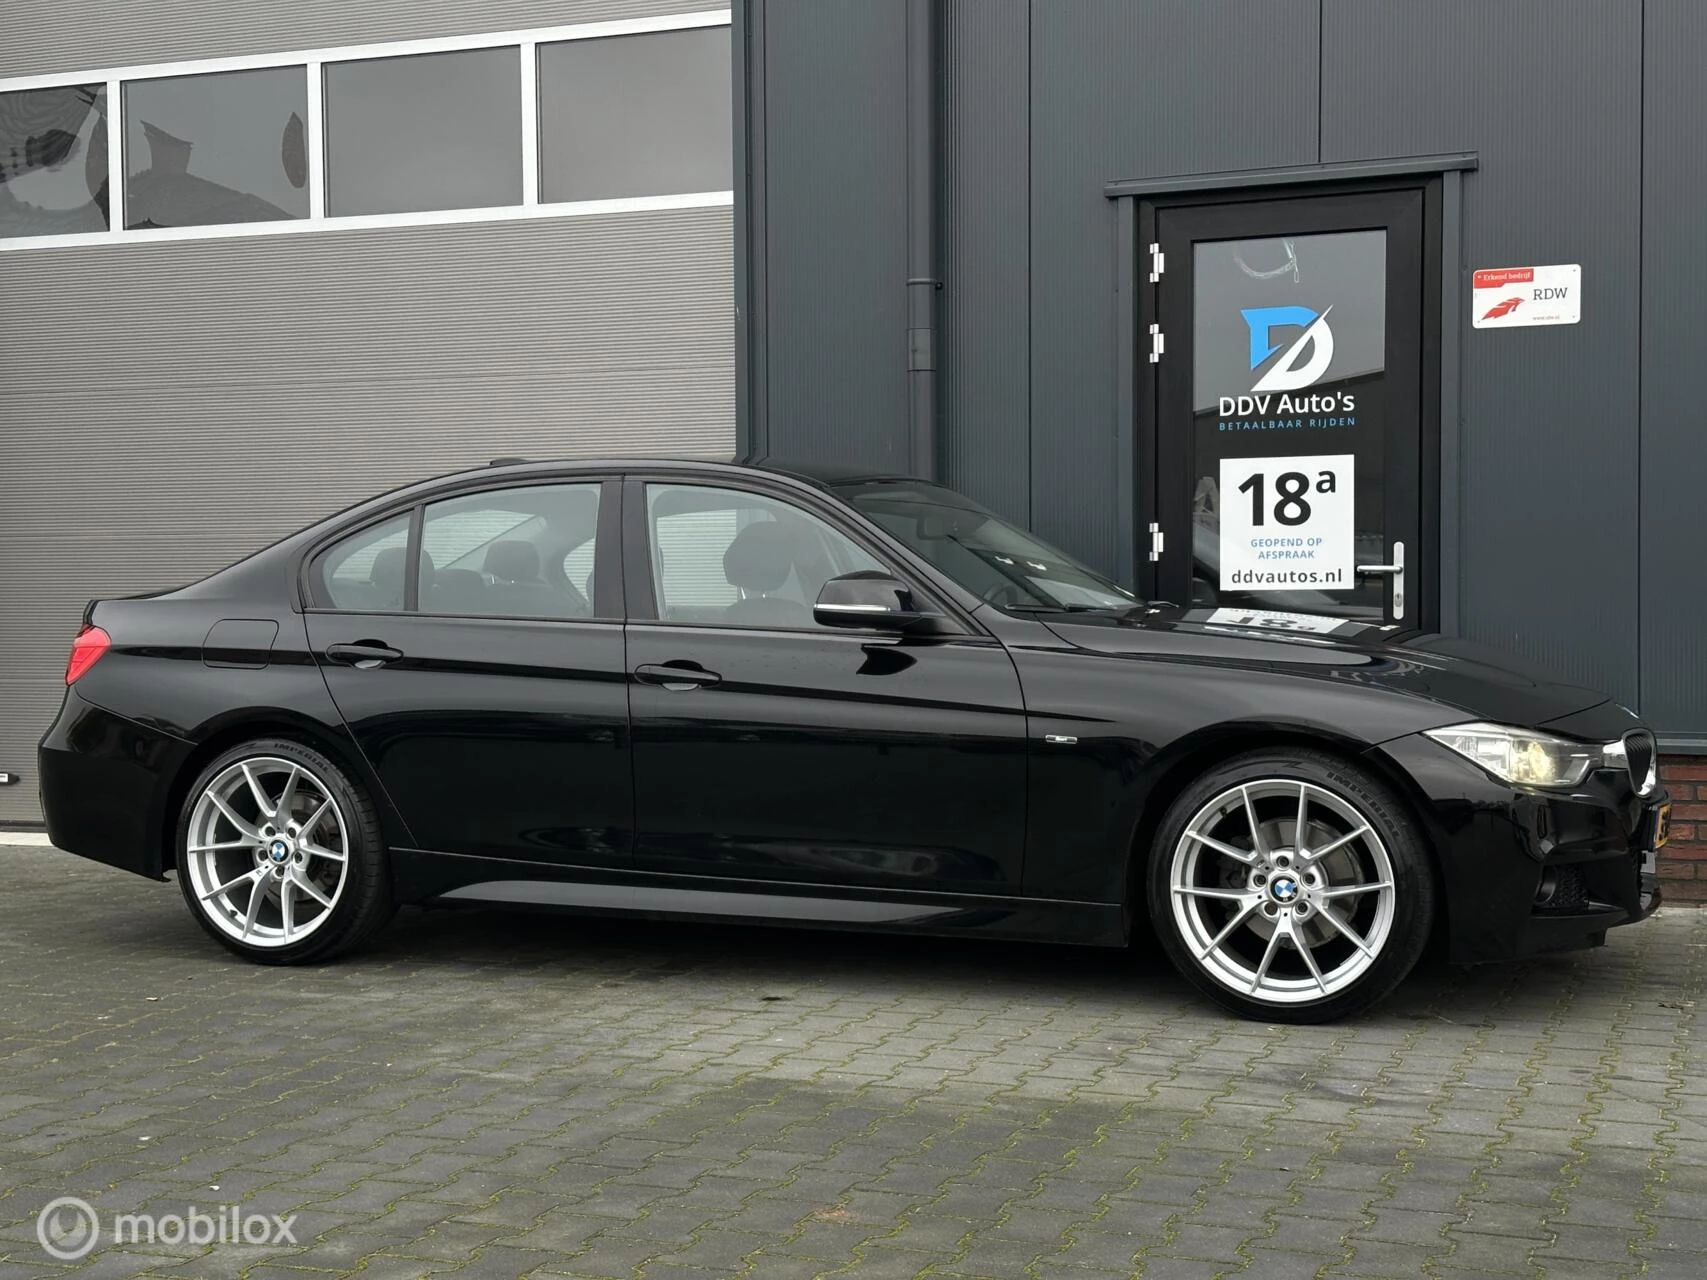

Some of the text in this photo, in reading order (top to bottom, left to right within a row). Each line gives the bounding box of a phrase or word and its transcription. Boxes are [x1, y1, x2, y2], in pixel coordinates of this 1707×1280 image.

[1483, 271, 1531, 281] Erkend bedrijf
[1533, 287, 1568, 301] RDW
[1219, 391, 1355, 417] DDV Auto's
[1219, 417, 1355, 431] BETAALBAAR RIJDEN
[1250, 537, 1322, 548] GEOPEND OP
[1258, 550, 1315, 560] AFSPRAAK
[1231, 568, 1342, 584] ddvautos.nl
